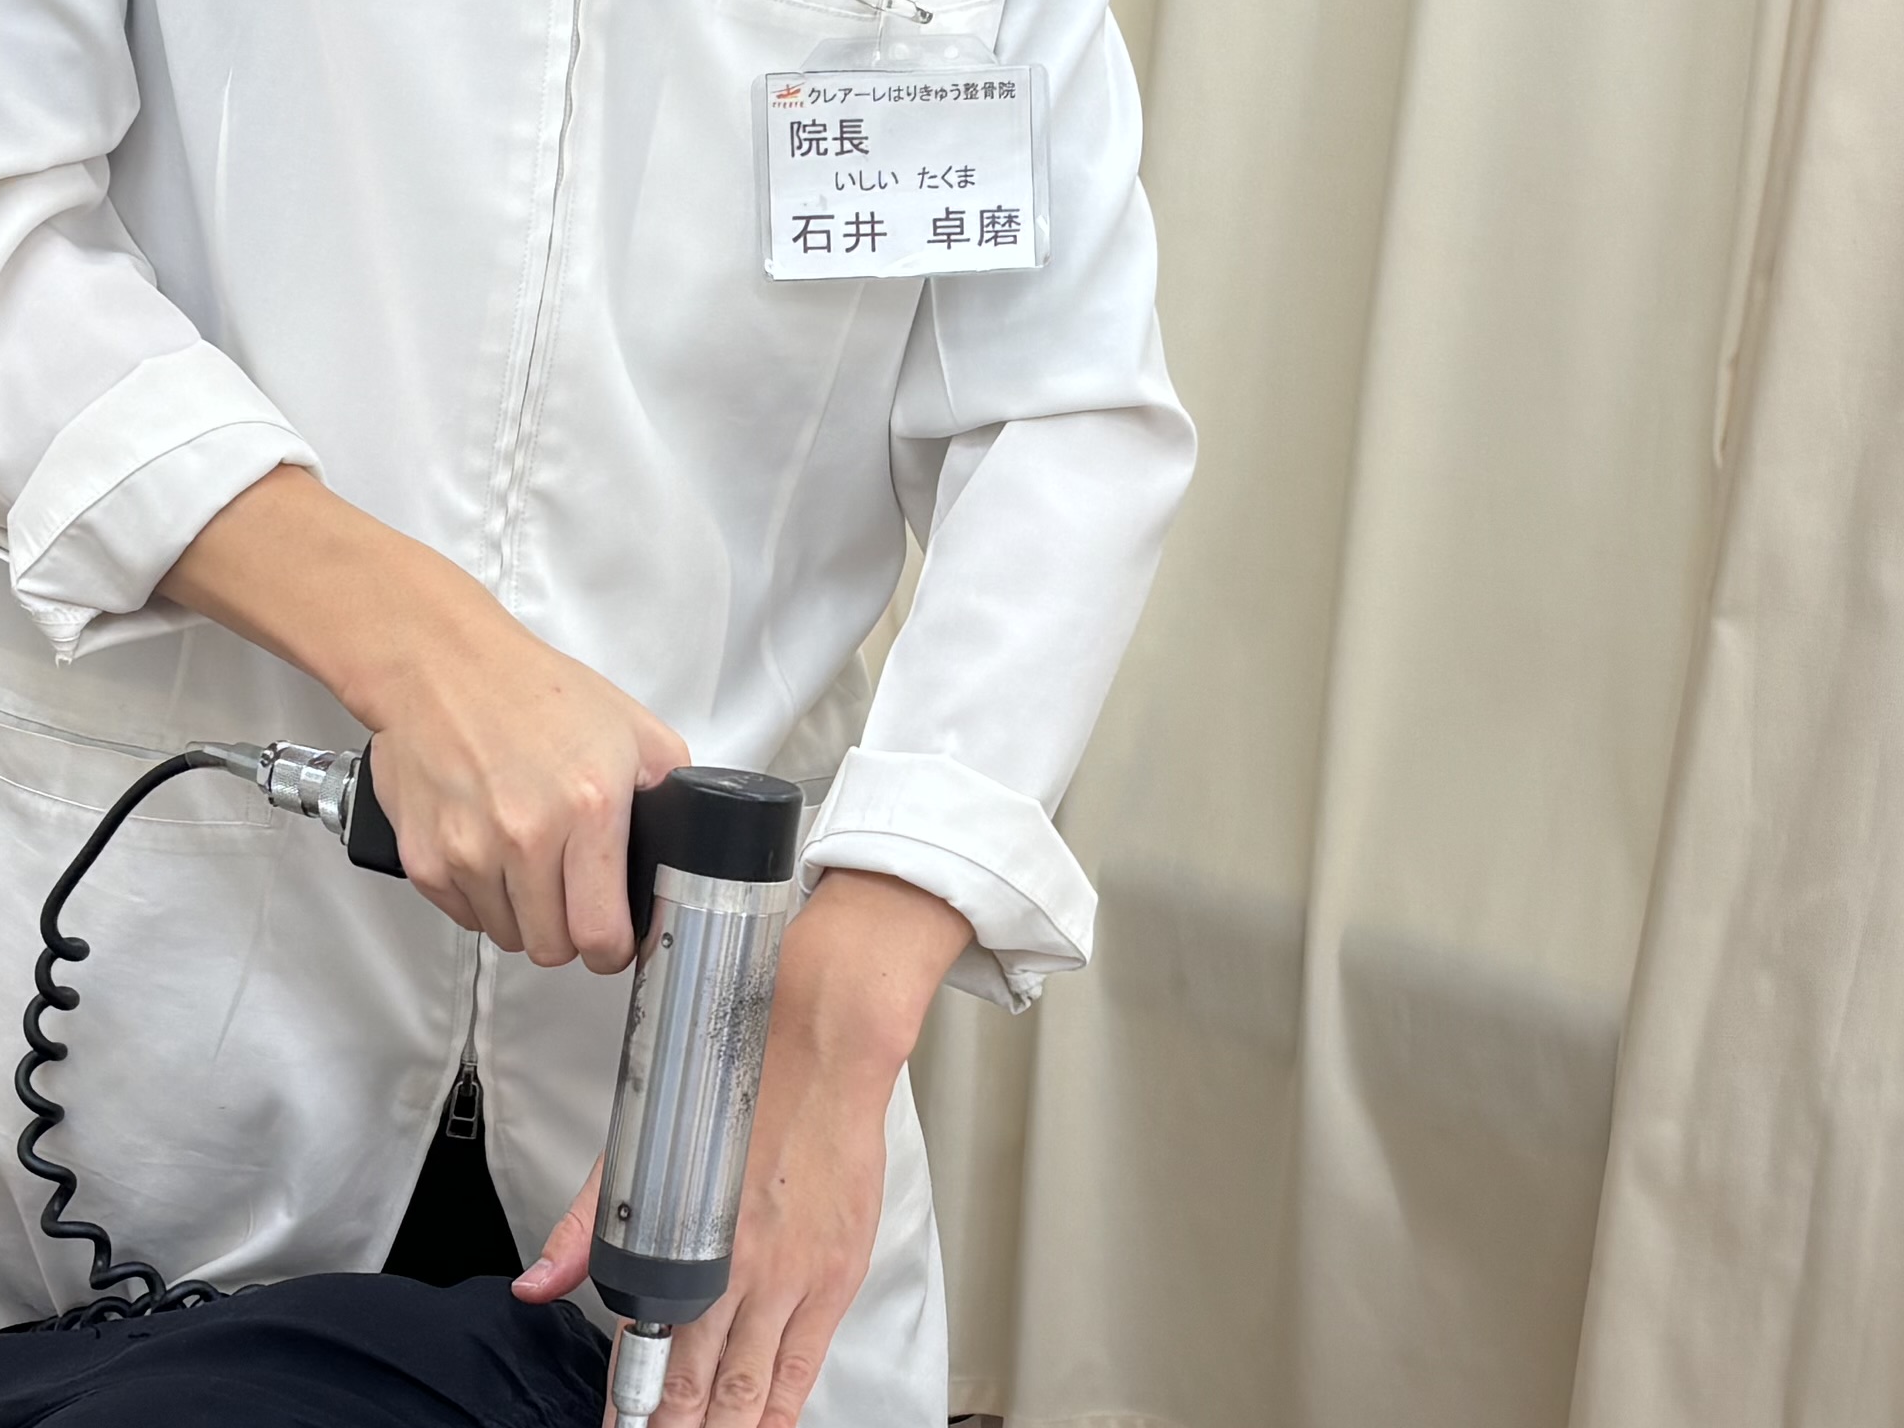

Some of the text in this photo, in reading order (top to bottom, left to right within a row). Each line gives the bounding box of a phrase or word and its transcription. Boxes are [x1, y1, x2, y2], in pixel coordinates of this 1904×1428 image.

[808, 80, 1016, 105] クレアーレはりきゅう整骨院
[789, 118, 870, 158] 院長
[834, 165, 976, 191] いしい たくま
[791, 204, 1022, 254] 石井 卓磨
